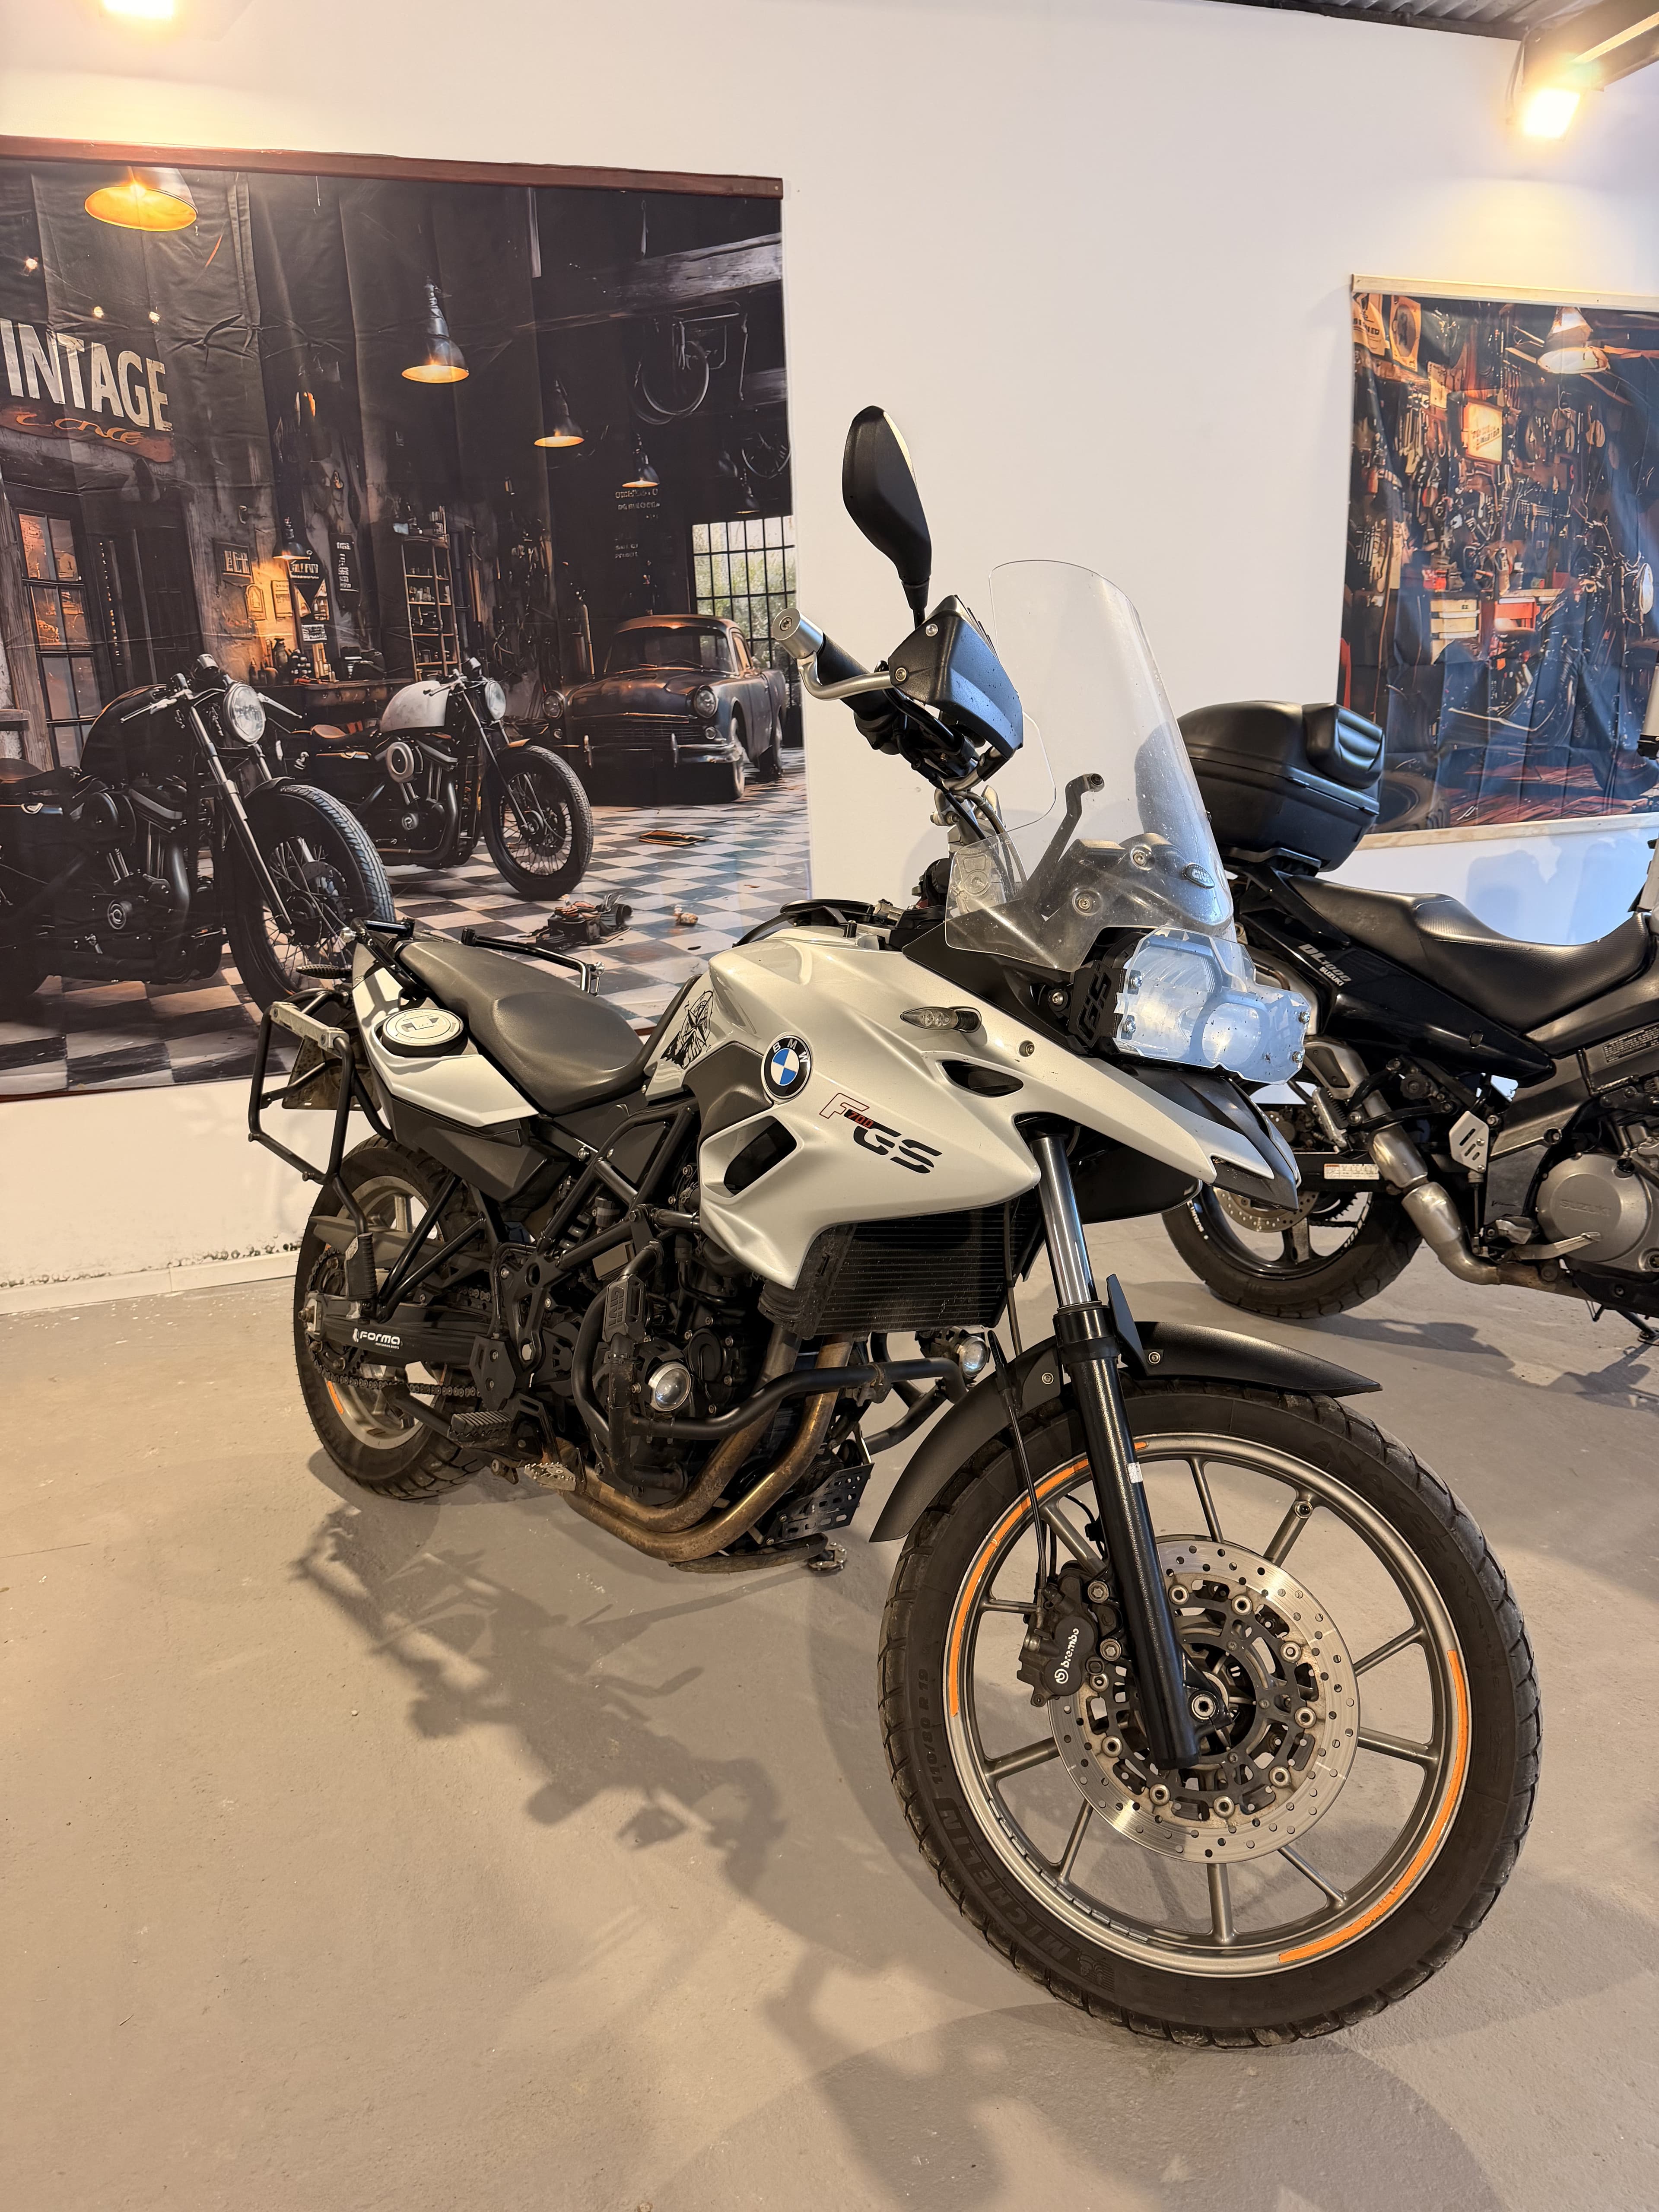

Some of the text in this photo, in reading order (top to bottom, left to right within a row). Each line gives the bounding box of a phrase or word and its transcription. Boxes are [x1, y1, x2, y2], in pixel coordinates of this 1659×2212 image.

[1319, 966, 1344, 986] SUZUKI
[772, 1038, 809, 1063] BMW
[819, 1093, 943, 1174] F 700 GS
[1559, 1199, 1612, 1217] SUZUKI
[608, 1290, 624, 1327] GIVI
[1060, 1628, 1079, 1669] brembo
[918, 1668, 929, 1691] 19
[918, 1696, 929, 1710] R
[920, 1717, 944, 1785] 110/80
[938, 1809, 1071, 1960] MICHELIN
